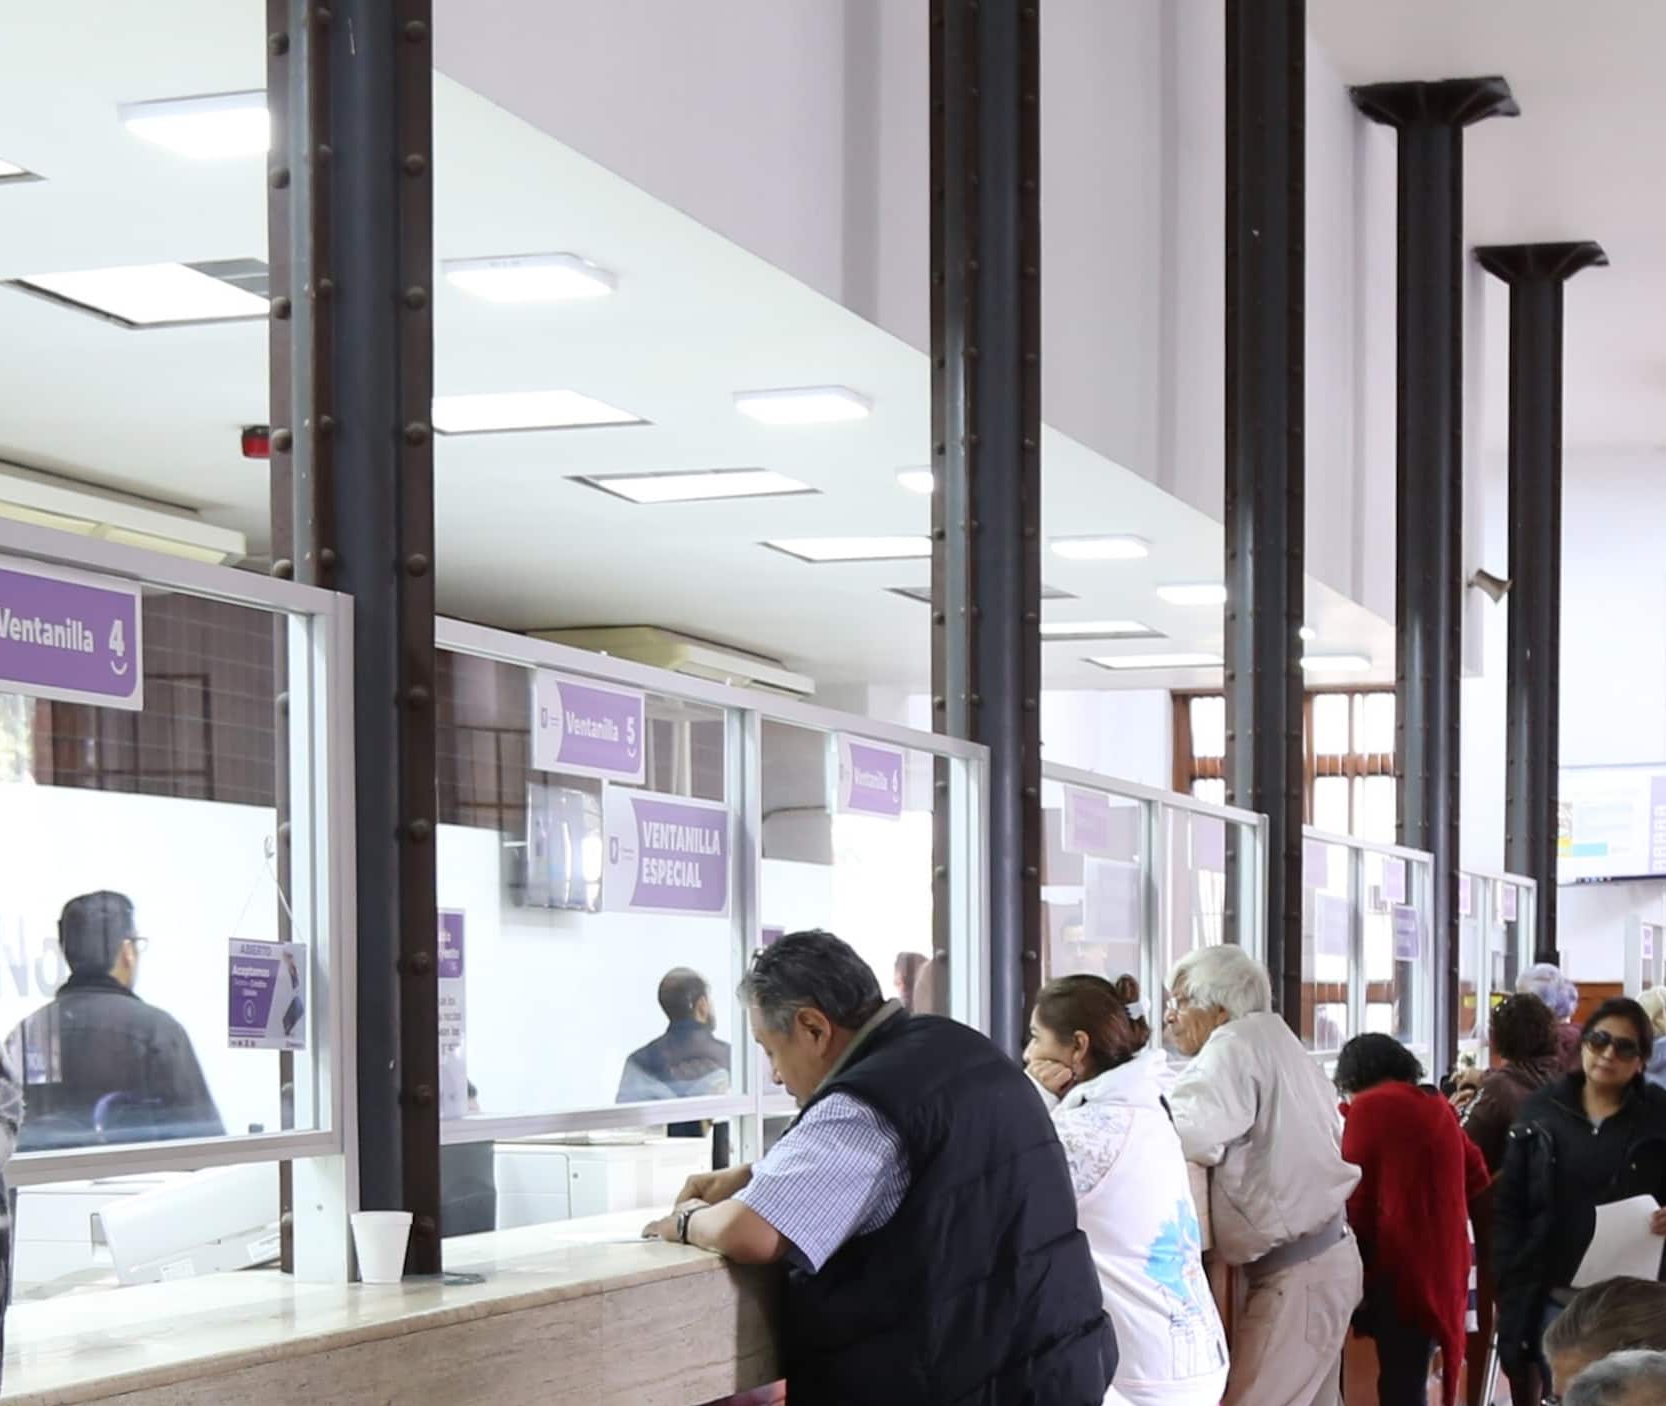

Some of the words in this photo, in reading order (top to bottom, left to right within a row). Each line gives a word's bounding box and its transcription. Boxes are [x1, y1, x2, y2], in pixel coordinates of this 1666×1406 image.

[109, 619, 126, 657] 4
[566, 711, 619, 742] Ventanilla
[626, 716, 636, 744] 5
[642, 820, 721, 856] VENTANILLA
[642, 857, 702, 888] ESPECIAL
